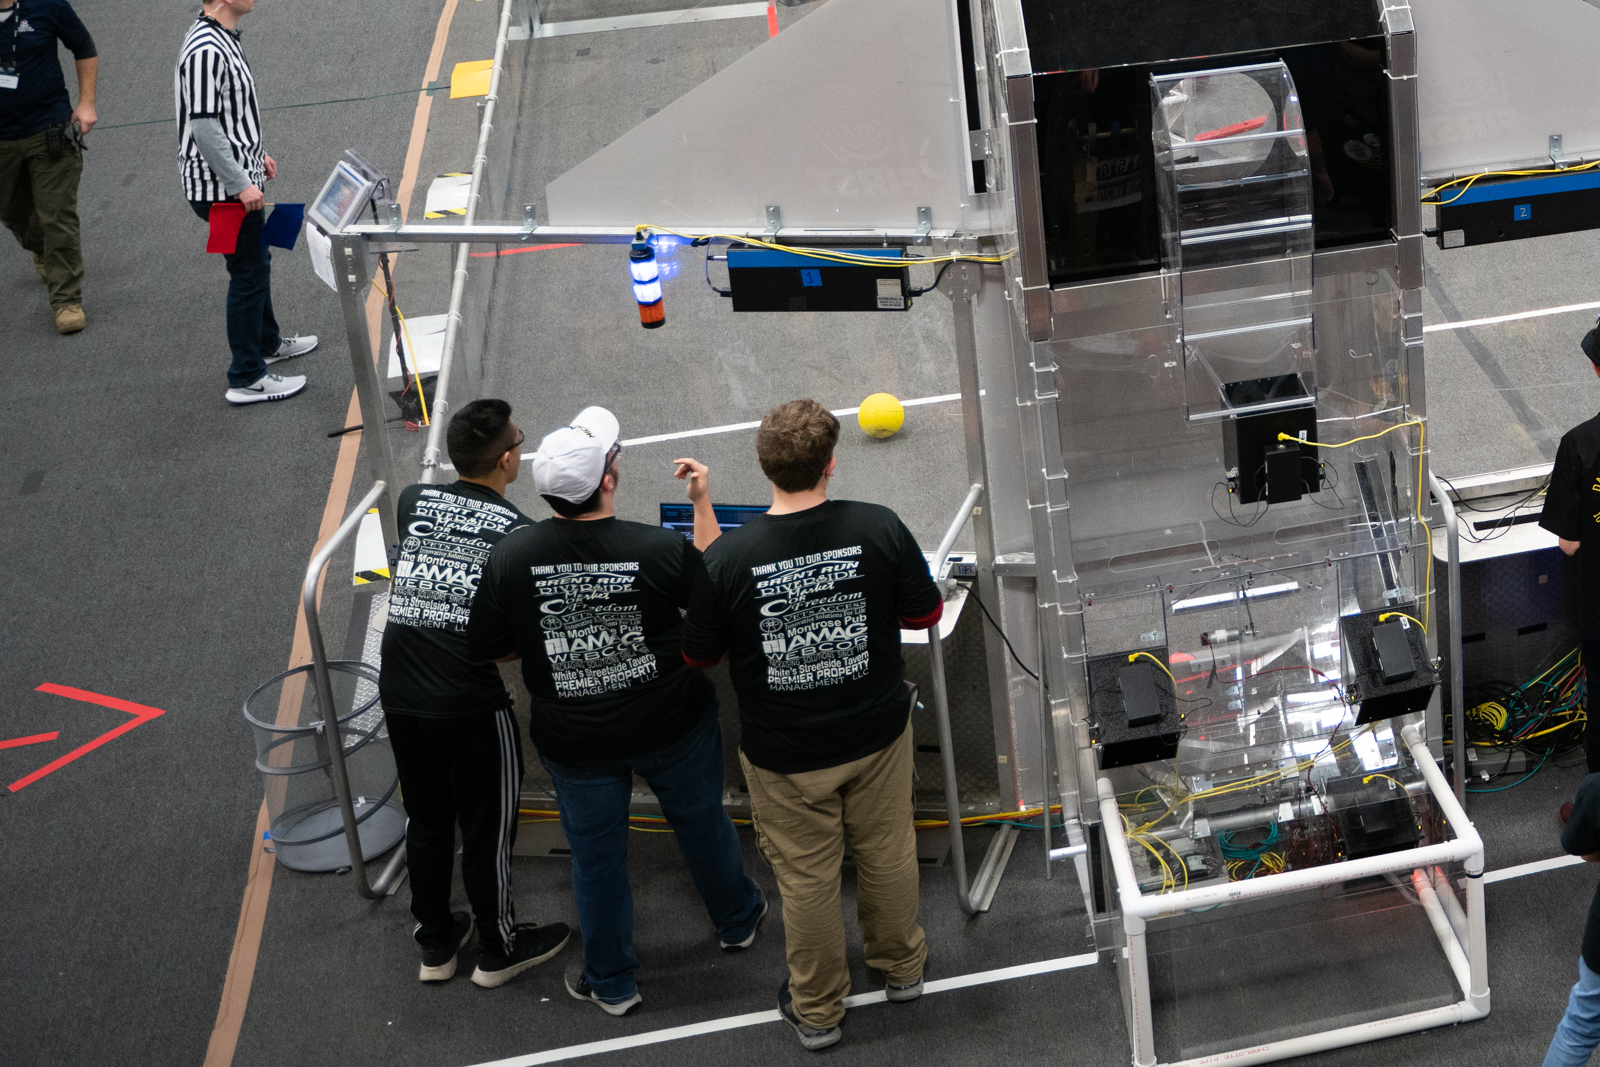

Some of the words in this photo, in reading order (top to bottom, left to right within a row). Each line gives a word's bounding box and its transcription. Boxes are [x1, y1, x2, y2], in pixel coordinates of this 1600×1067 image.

[1520, 208, 1527, 217] 2
[806, 272, 814, 283] 1
[441, 492, 455, 503] YOU
[457, 496, 465, 505] TO
[466, 498, 481, 509] OUR
[416, 500, 472, 515] BRENT
[475, 512, 512, 526] RUN
[400, 552, 415, 561] The
[417, 554, 467, 570] Montrose
[531, 565, 555, 575] THANK
[557, 564, 572, 573] YOU
[573, 563, 582, 572] TO
[600, 562, 640, 571] SPONSORS
[751, 566, 777, 576] THANK
[779, 560, 794, 571] YOU
[795, 557, 805, 567] TO
[806, 553, 822, 564] OUR
[823, 545, 862, 560] SPONSORS
[535, 576, 594, 587] BRENT
[597, 576, 636, 584] RUN
[757, 569, 817, 589] BRENT
[821, 561, 860, 574] RUN
[788, 582, 835, 599] Market
[410, 597, 450, 611] Streetside
[792, 592, 863, 611] Freedom
[818, 601, 867, 613] ACCESS
[815, 612, 843, 622] Solutions
[543, 630, 566, 639] The
[620, 624, 643, 634] Pub
[762, 632, 785, 641] The
[787, 619, 842, 638] Montrose
[844, 614, 867, 626] Pub
[787, 623, 868, 653] AMAG
[766, 635, 868, 661] WEBCOR
[803, 651, 835, 664] SOLUTIONS
[837, 647, 854, 658] SINCE
[551, 668, 584, 681] White's
[627, 653, 656, 669] Tavern
[768, 665, 797, 676] White's
[799, 658, 841, 673] Streetside
[844, 650, 869, 665] Tavern
[768, 673, 814, 684] PREMIER
[817, 658, 869, 679] PROPERTY
[555, 676, 601, 691] PREMIER
[602, 660, 657, 685] PROPERTY
[640, 671, 659, 684] LLC
[770, 676, 844, 691] MANAGEMENT
[852, 668, 869, 681] LLC
